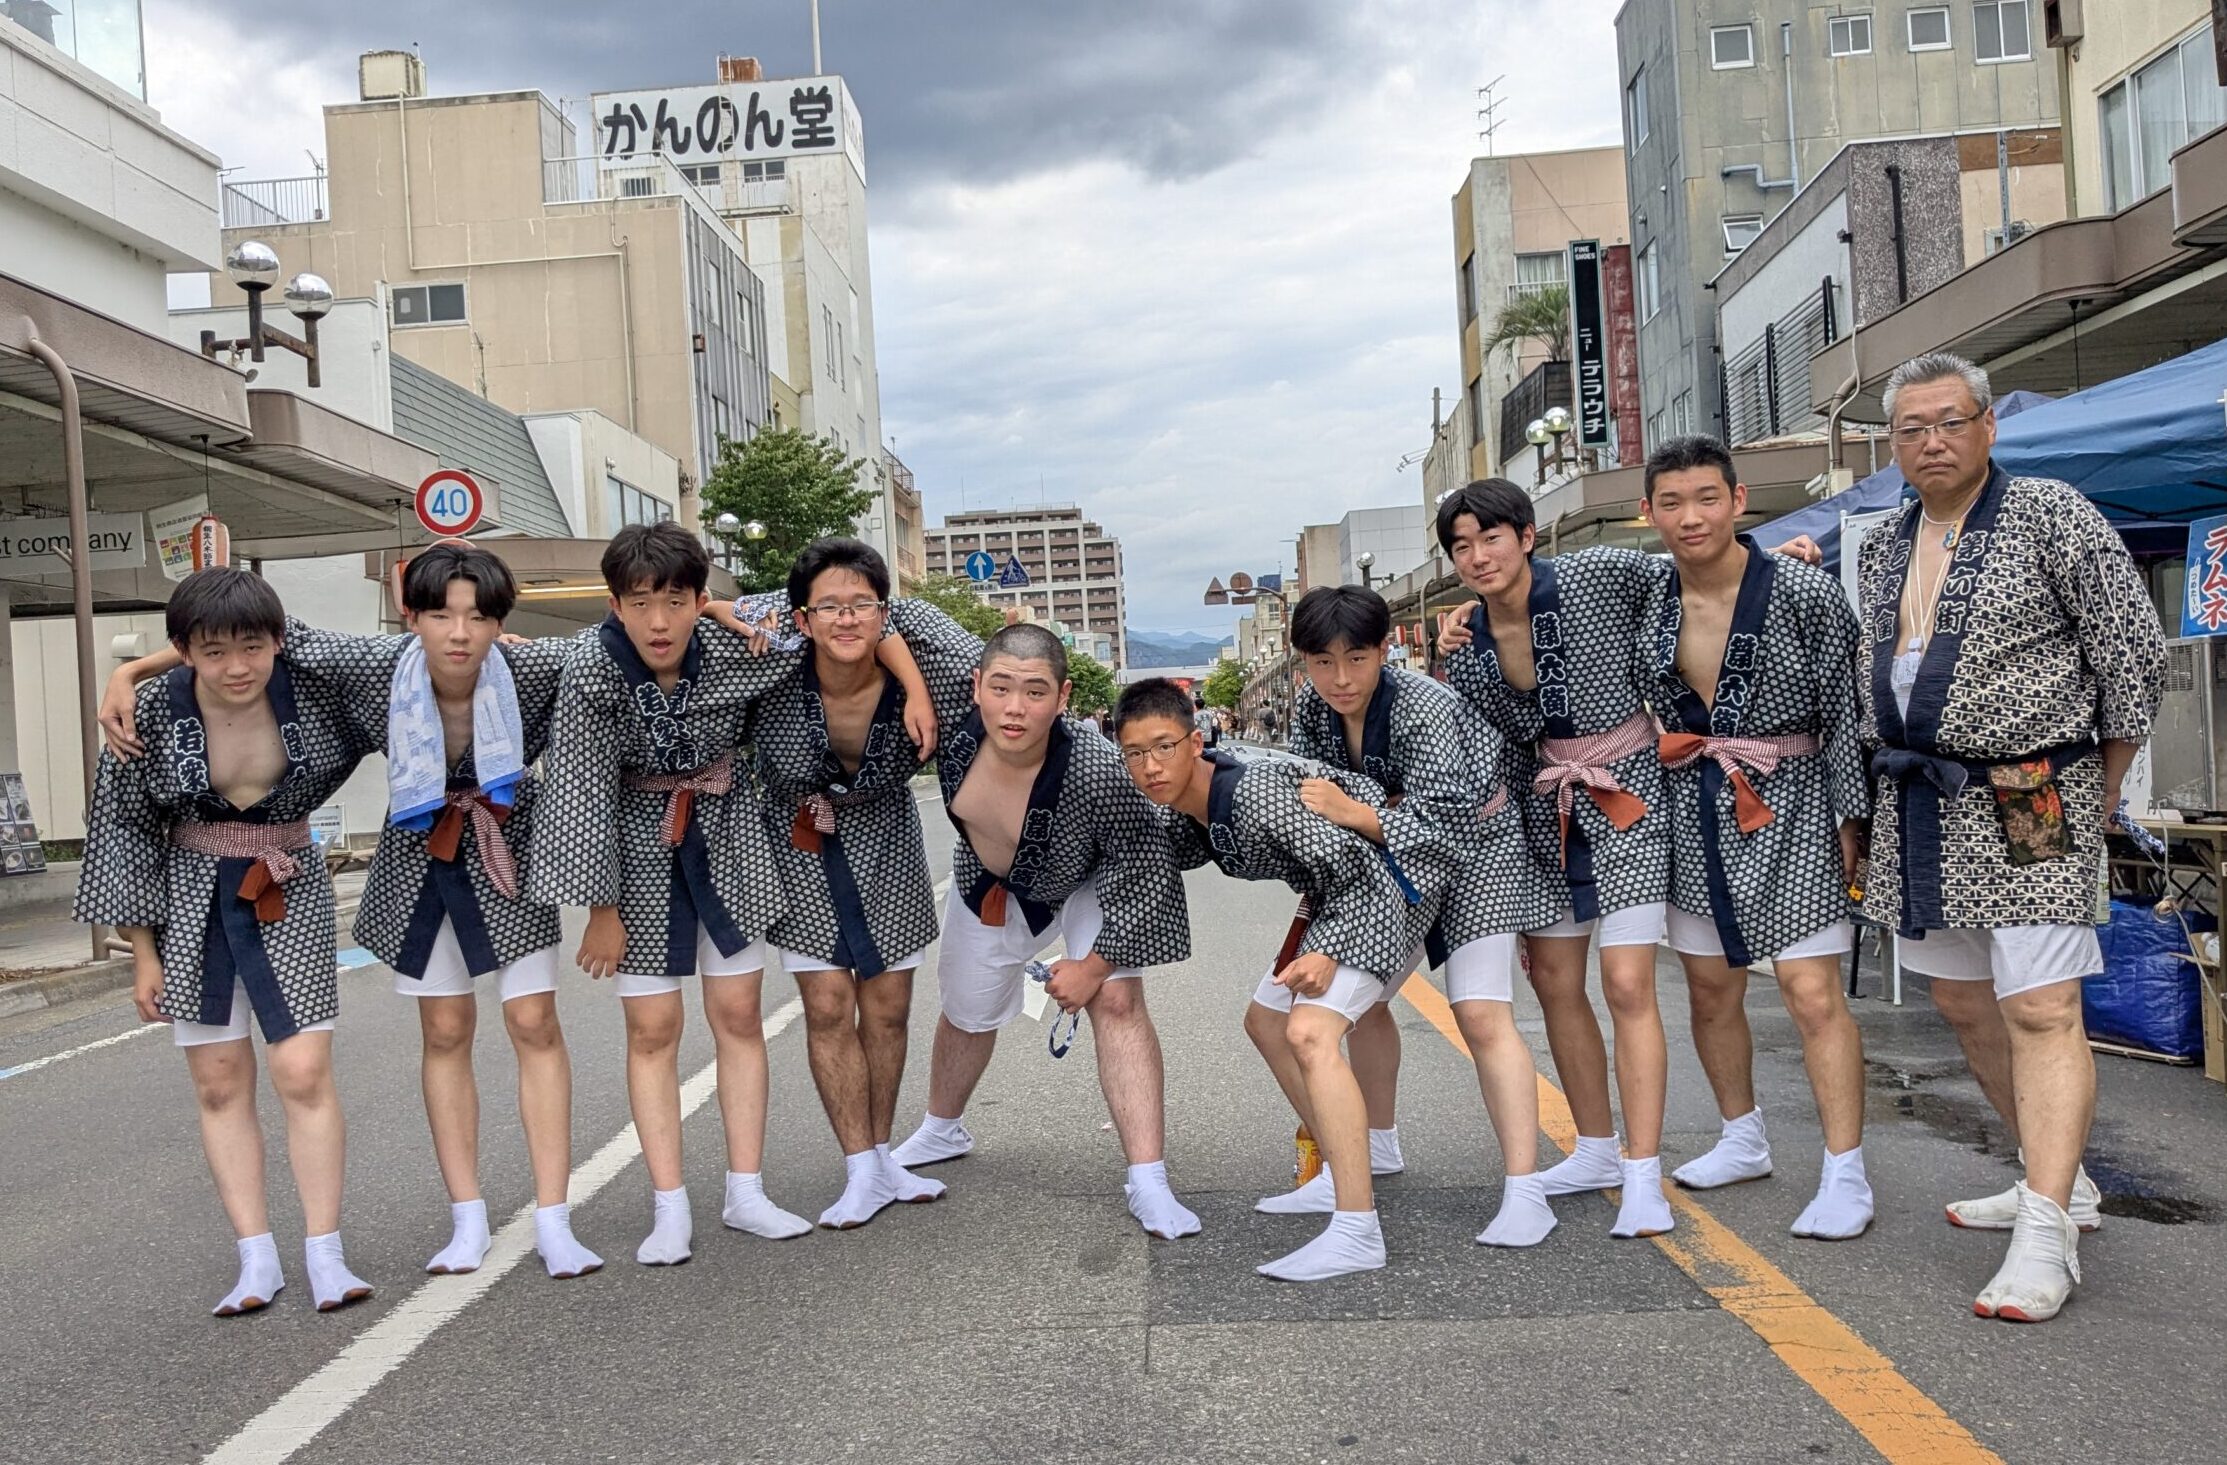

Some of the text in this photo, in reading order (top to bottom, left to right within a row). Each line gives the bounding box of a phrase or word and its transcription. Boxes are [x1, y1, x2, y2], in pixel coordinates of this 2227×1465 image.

[603, 85, 835, 160] かんのん堂
[1574, 245, 1590, 253] FINE
[1575, 252, 1596, 261] SHOES
[1580, 328, 1605, 435] ニュー テラウチ
[431, 488, 467, 517] 40
[0, 531, 132, 555] t comany
